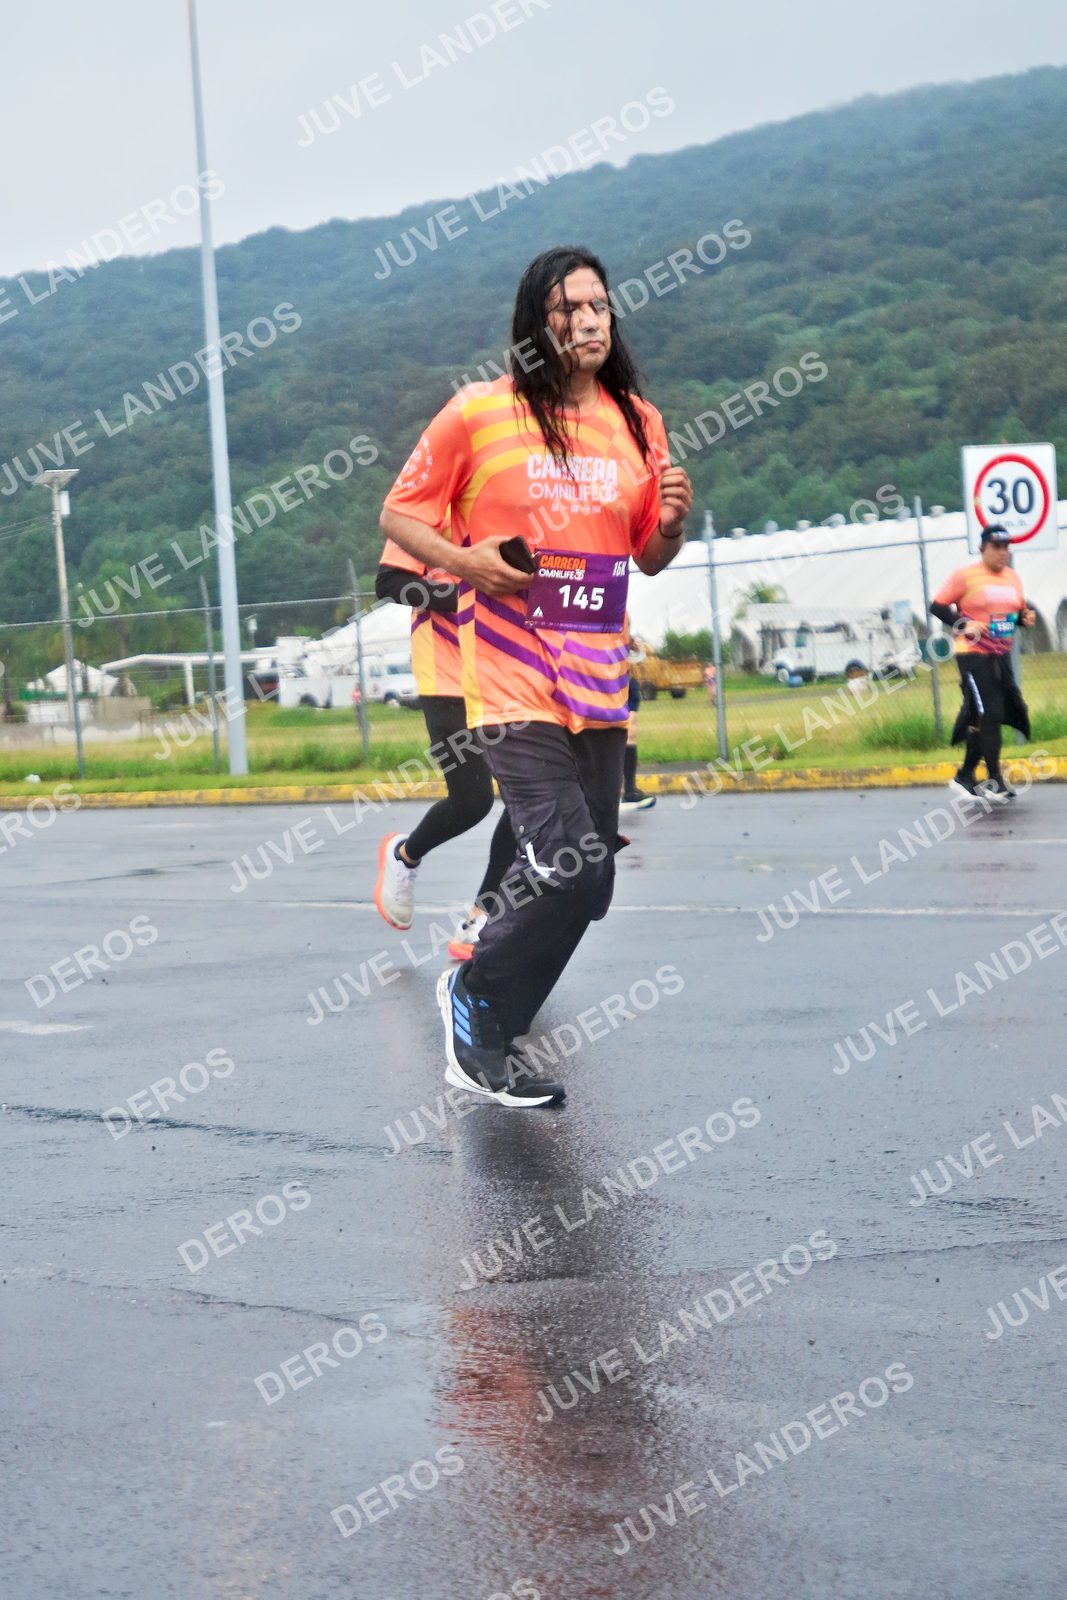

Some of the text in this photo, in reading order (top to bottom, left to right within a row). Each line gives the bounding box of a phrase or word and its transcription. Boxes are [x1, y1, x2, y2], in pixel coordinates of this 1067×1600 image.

[987, 478, 1034, 515] 30
[540, 555, 587, 570] CARRERA
[538, 568, 575, 580] OMNILIFE
[558, 584, 605, 611] 145
